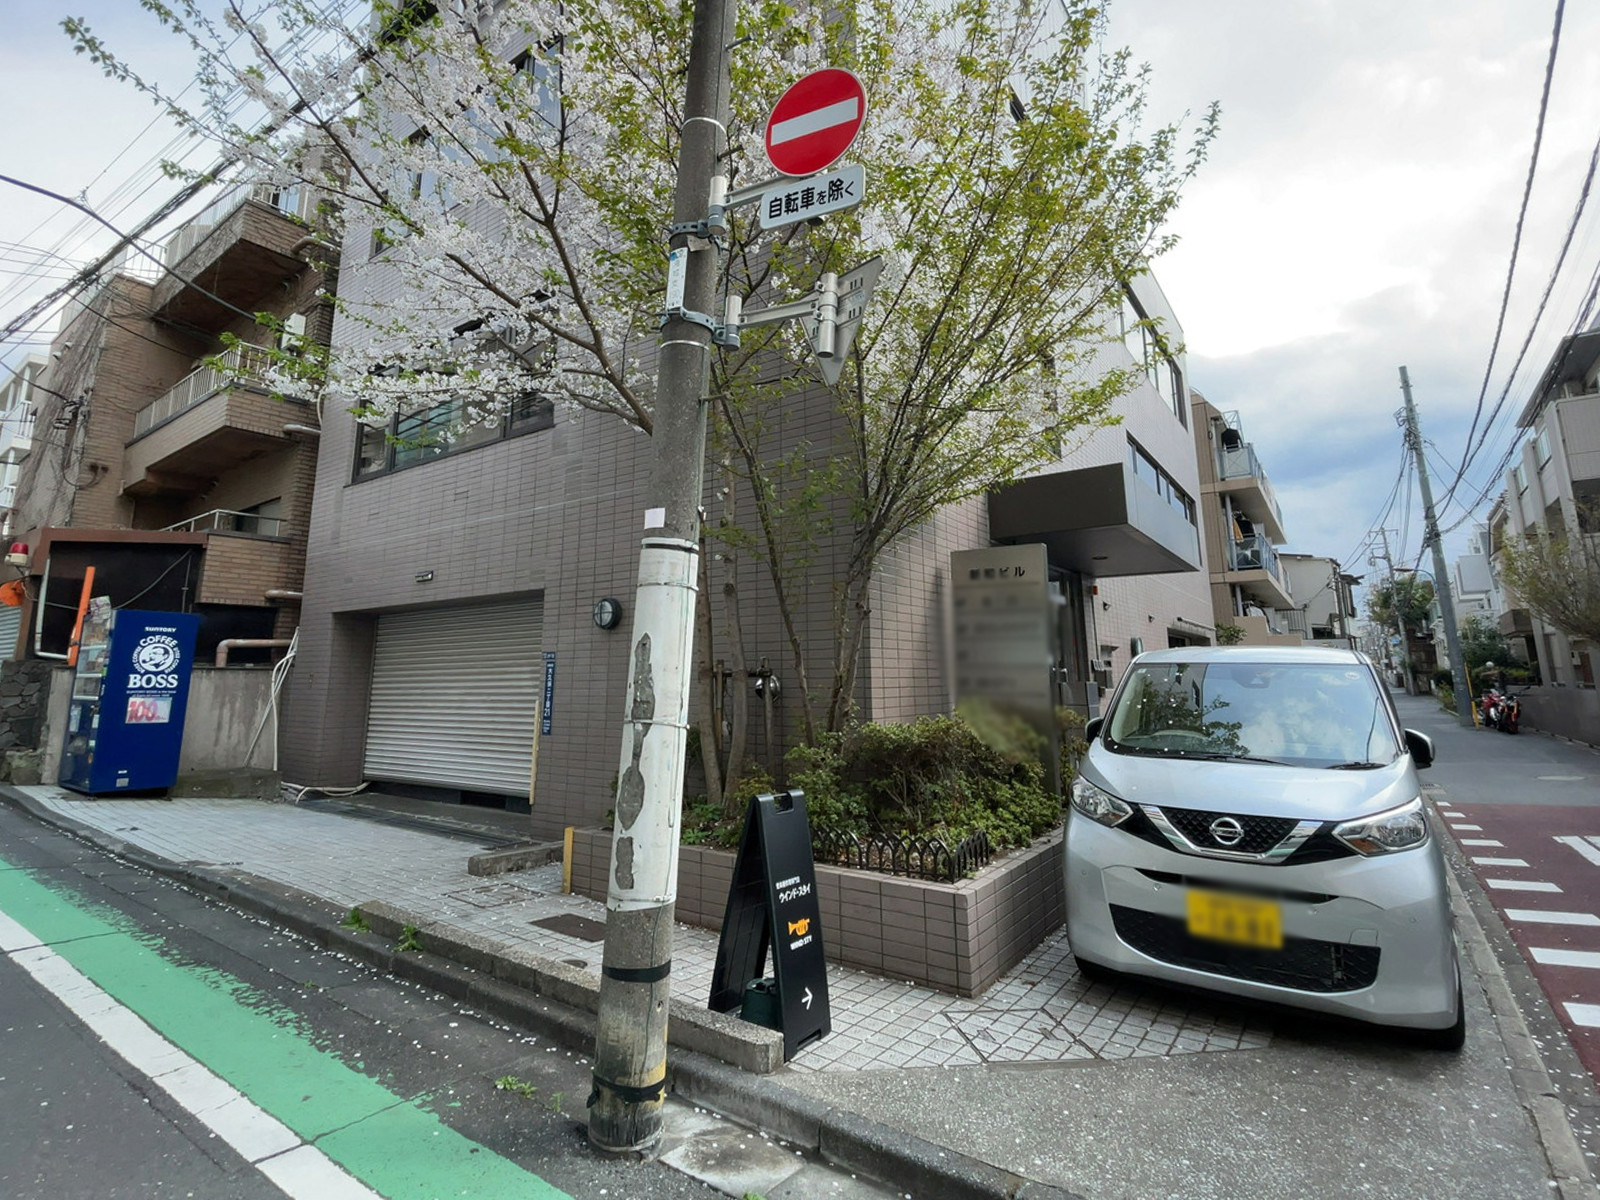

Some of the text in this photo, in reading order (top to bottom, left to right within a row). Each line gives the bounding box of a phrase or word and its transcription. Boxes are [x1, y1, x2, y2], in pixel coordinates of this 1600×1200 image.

[768, 177, 855, 219] 自転車を除く
[969, 566, 1026, 581] ビル
[140, 635, 178, 647] COFFEE
[127, 674, 178, 688] BOSS
[128, 700, 158, 722] 100
